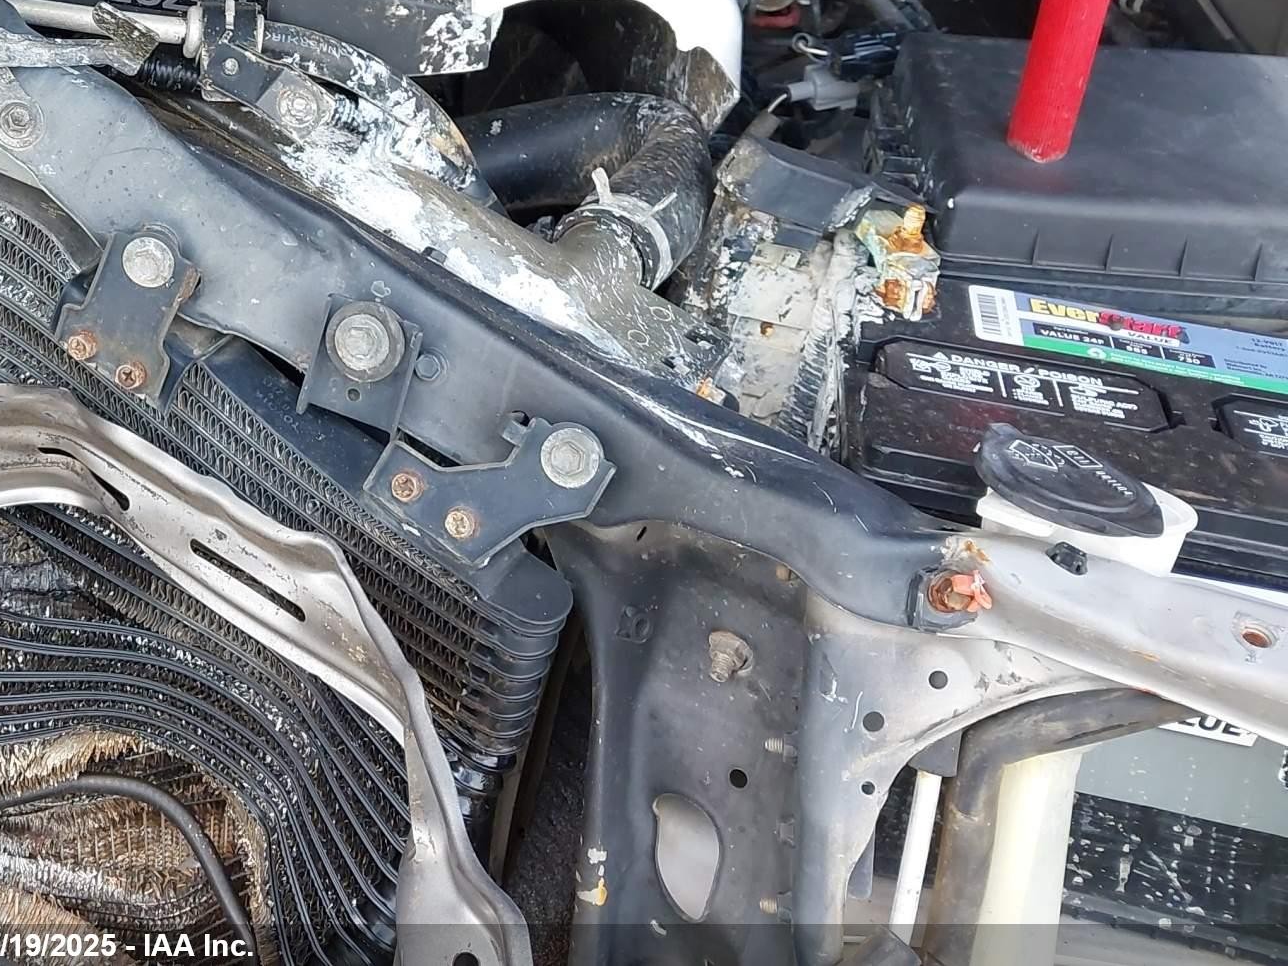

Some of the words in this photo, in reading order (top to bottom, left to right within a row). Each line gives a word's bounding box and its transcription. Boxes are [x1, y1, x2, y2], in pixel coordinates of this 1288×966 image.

[1030, 297, 1186, 339] EverStart
[1040, 328, 1080, 341] VALUE
[951, 354, 1020, 373] DANGER
[1038, 369, 1103, 387] POISON
